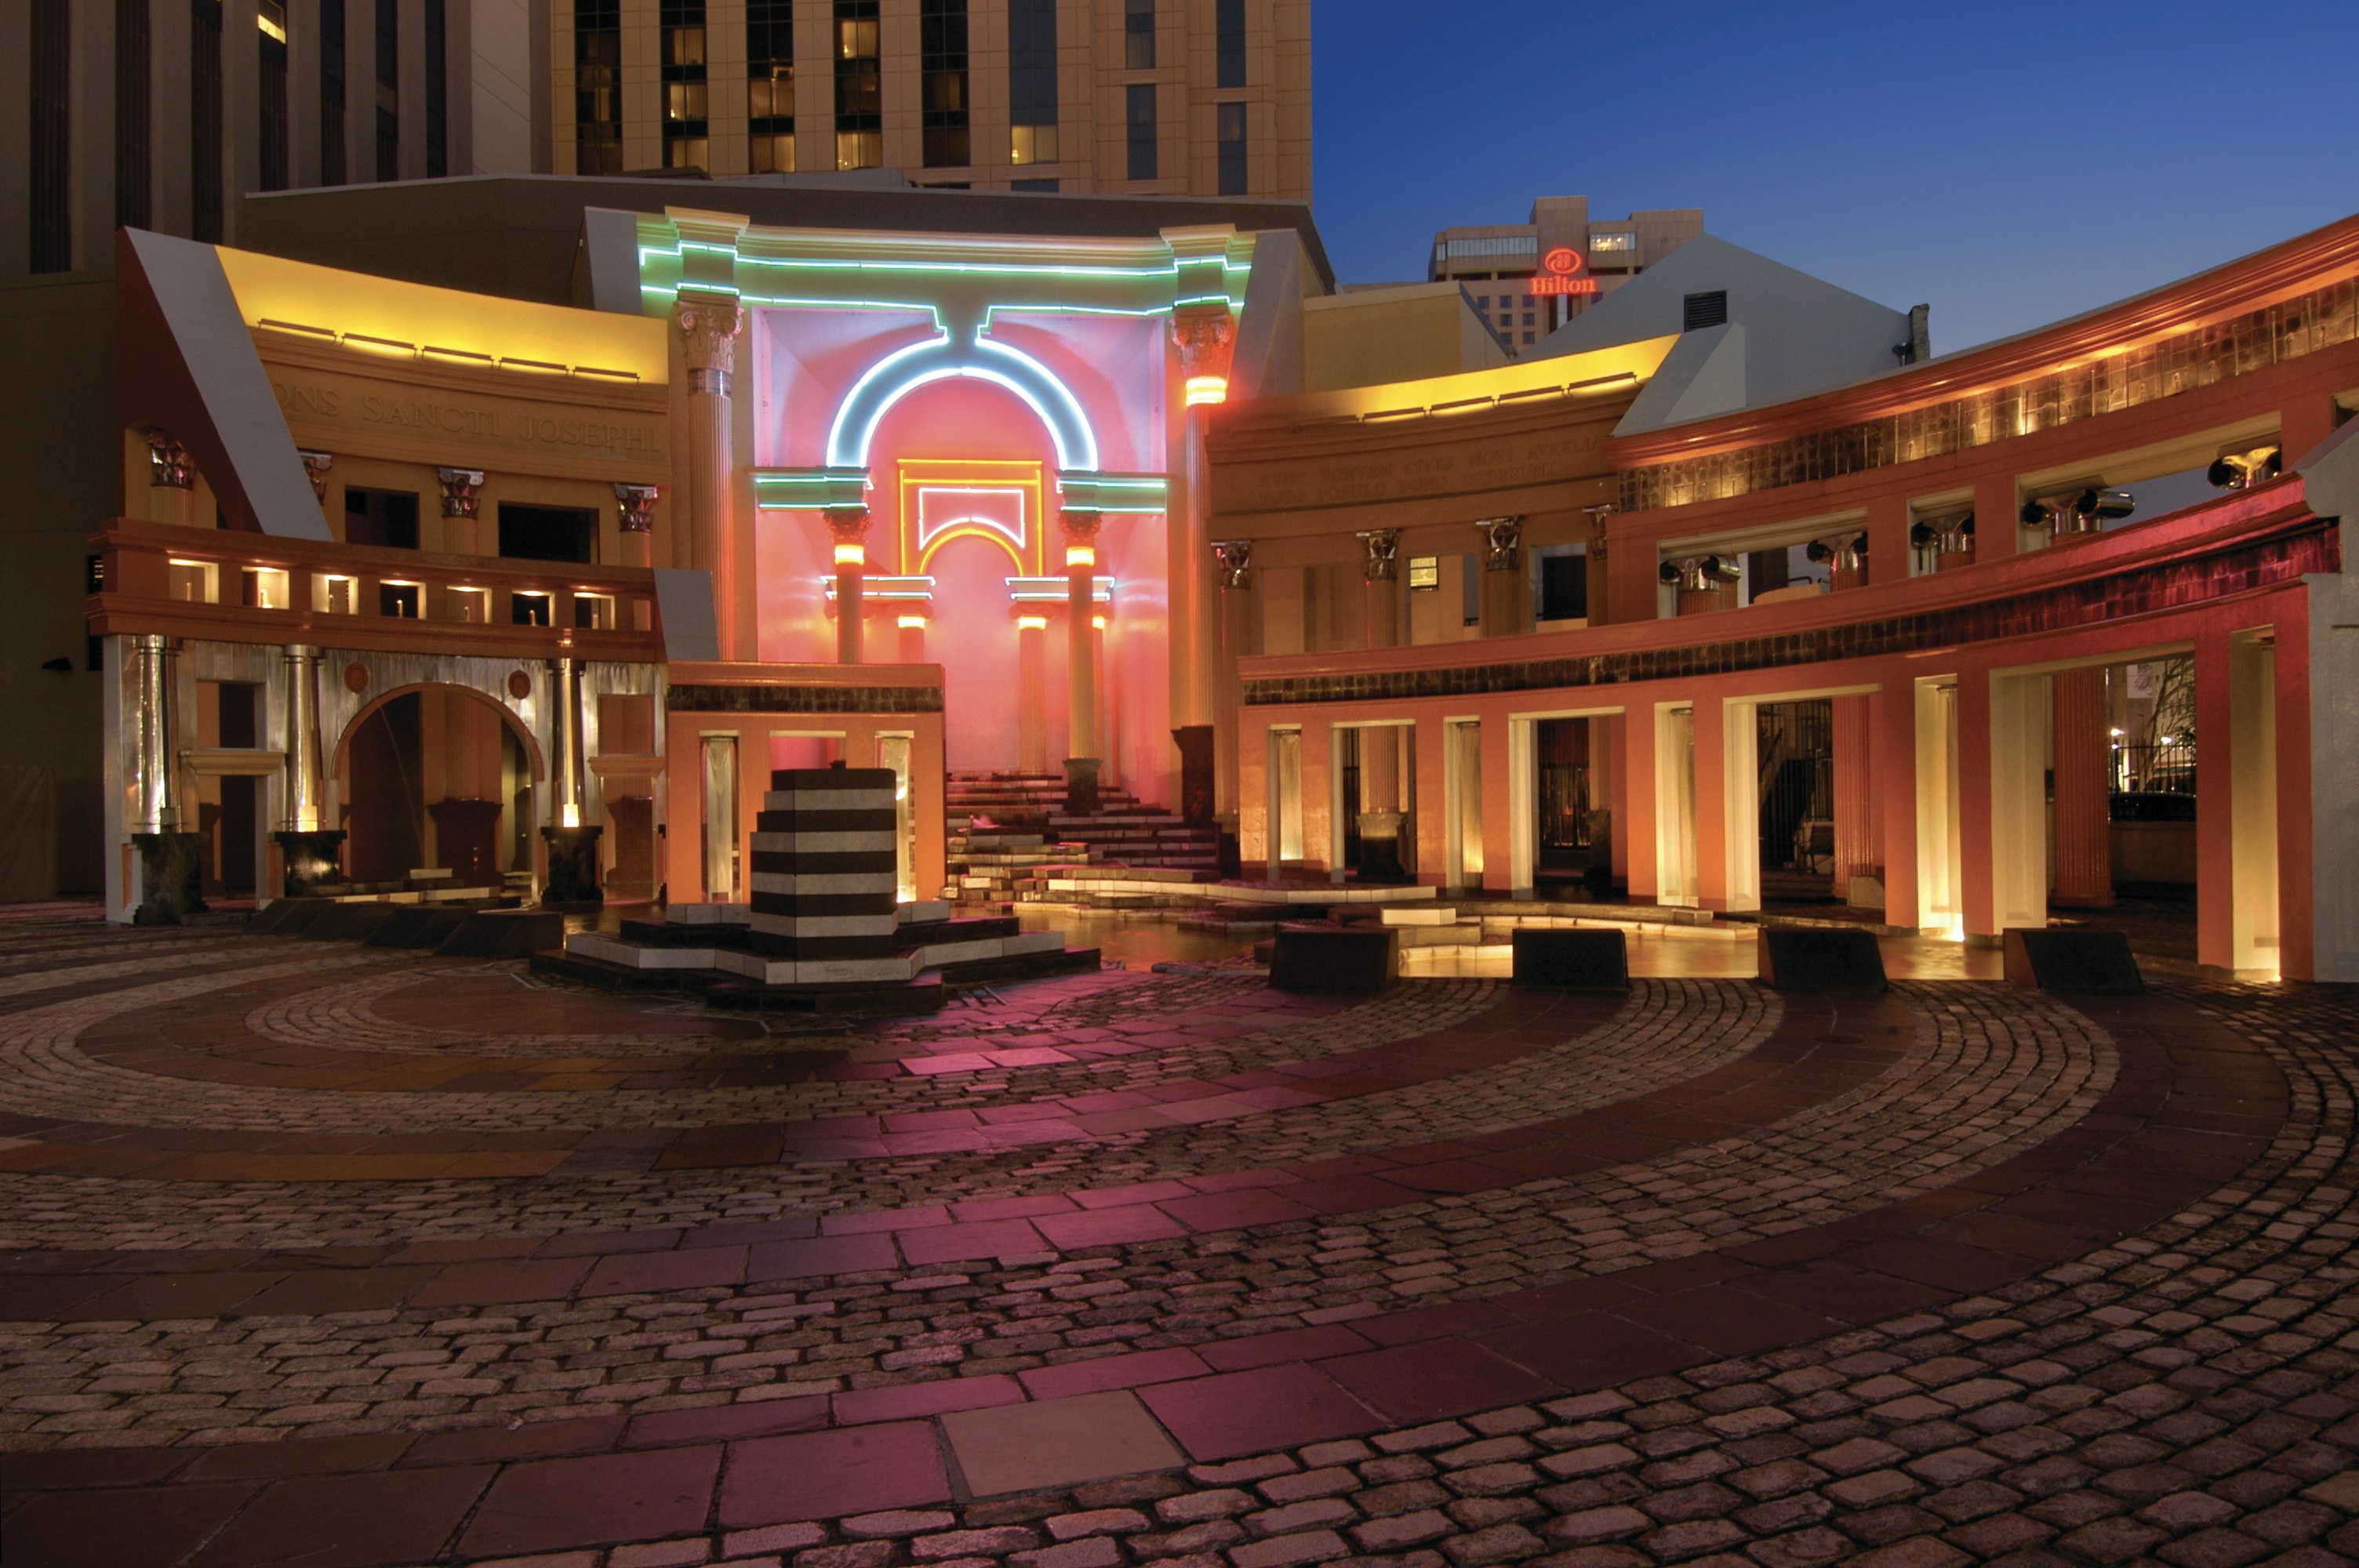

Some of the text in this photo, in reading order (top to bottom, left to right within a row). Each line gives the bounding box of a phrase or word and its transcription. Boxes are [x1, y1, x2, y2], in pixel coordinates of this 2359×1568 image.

[1530, 274, 1597, 295] Hilton
[363, 396, 500, 438] SANCTI
[520, 416, 660, 453] JOSEPHI
